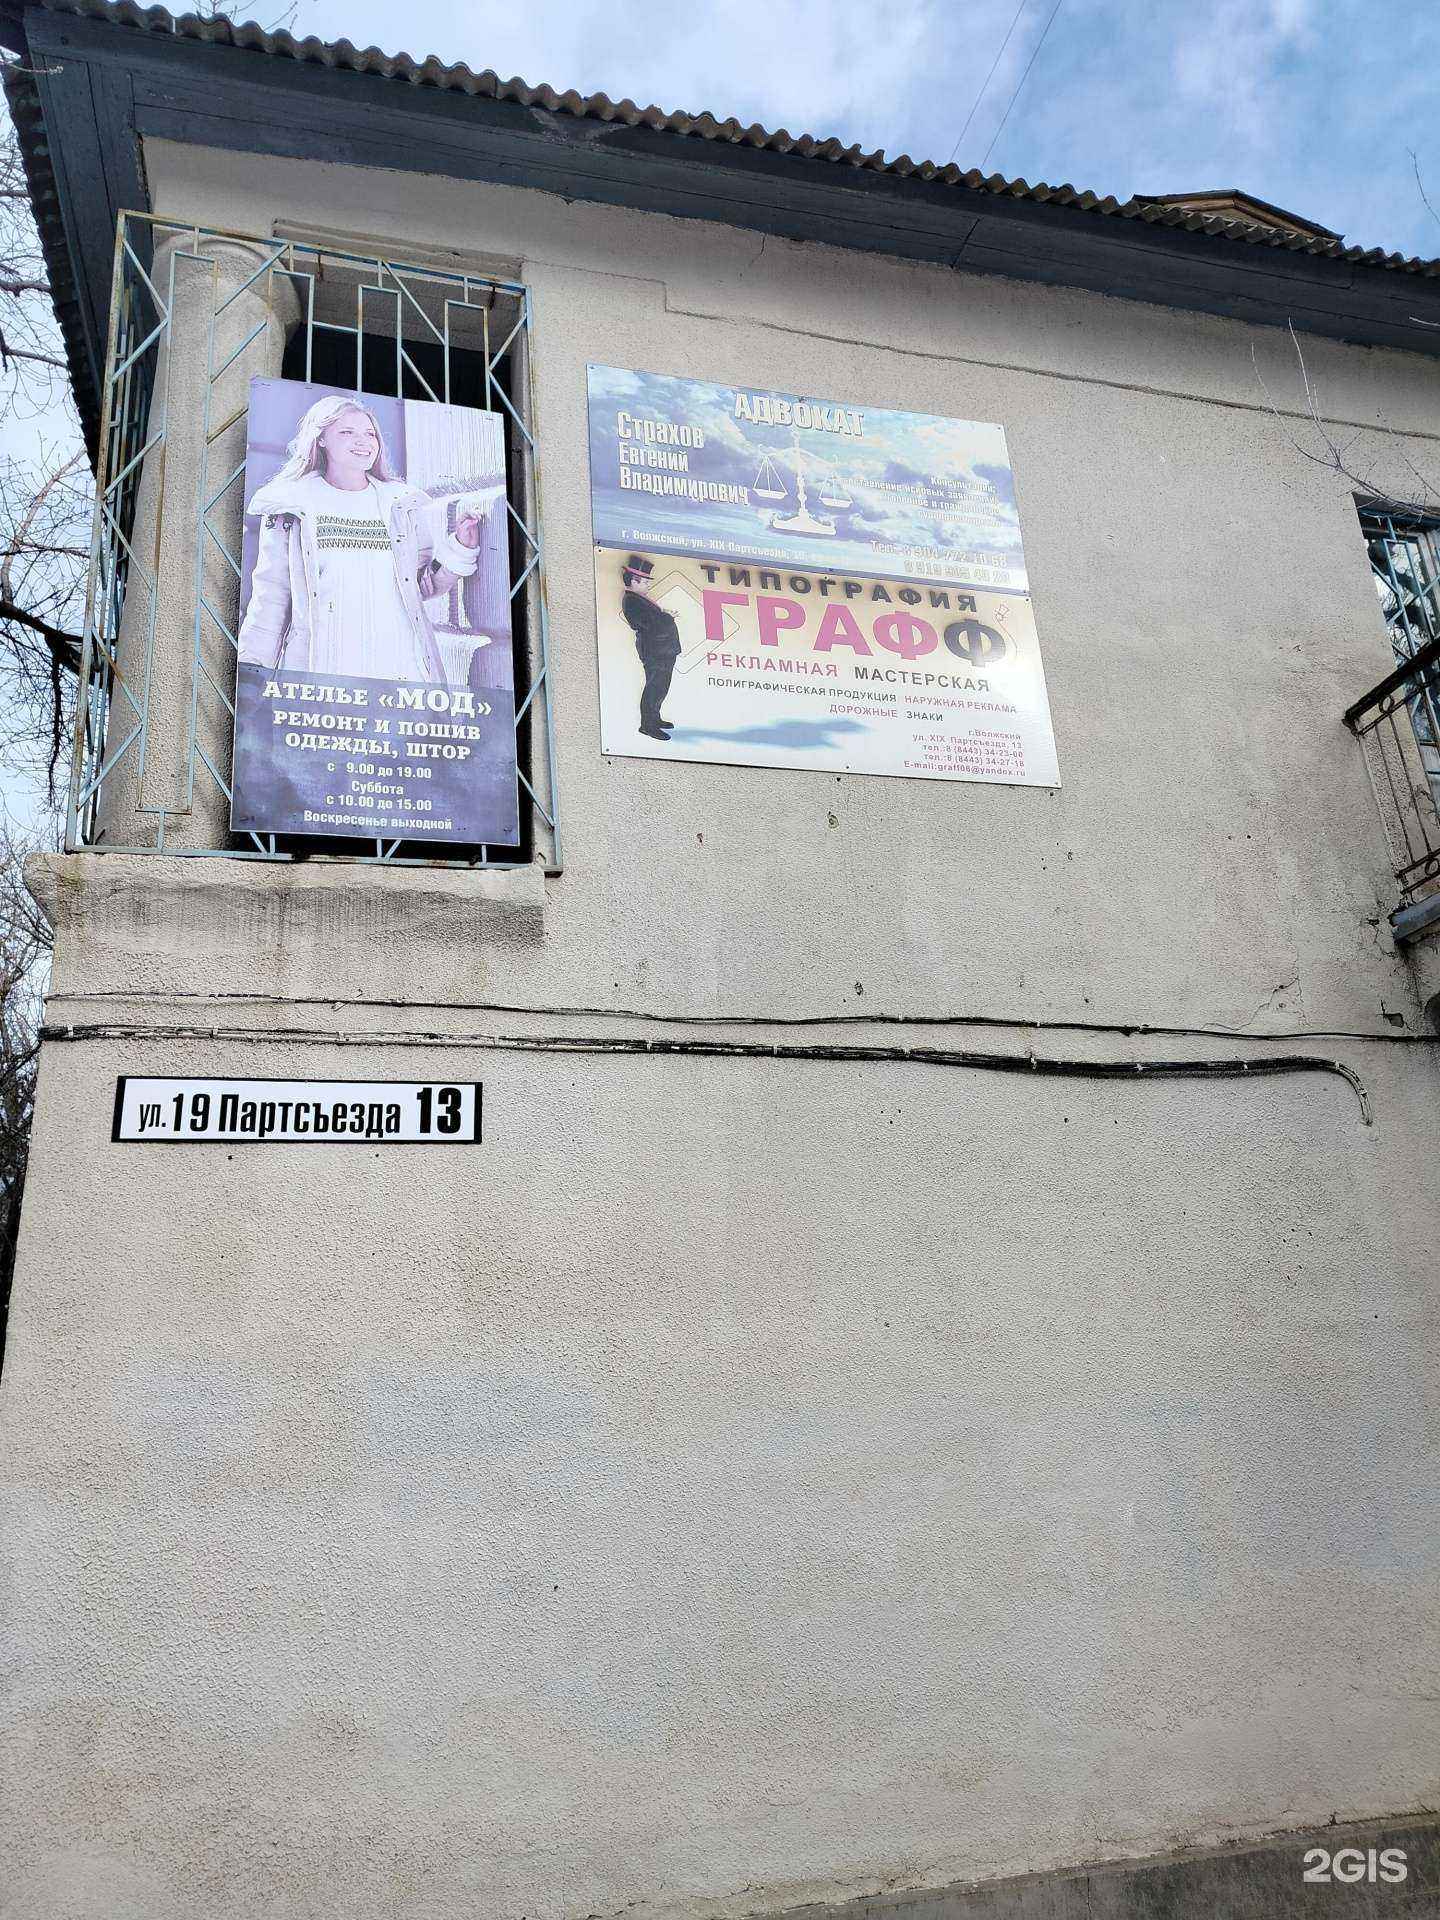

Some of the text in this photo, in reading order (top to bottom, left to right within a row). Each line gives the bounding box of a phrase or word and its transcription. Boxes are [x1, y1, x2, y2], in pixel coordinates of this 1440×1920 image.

[617, 412, 705, 449] Страхов
[735, 393, 864, 436] АДВОКАТ
[619, 442, 689, 472] Евгений
[620, 466, 750, 505] Владимирович
[622, 530, 629, 538] г.
[701, 565, 977, 612] ТИПОГРАФИЯ
[703, 590, 1006, 667] ГРАФФ
[706, 652, 990, 692] РЕКЛАМНАЯ МАСТЕРСКАЯ
[262, 681, 492, 718] АТЕЛЬЕ «МОД»
[708, 677, 1017, 713] ПОЛИГРАФИЧЕСКАЯ ПРОДУКЦИЯ НАРУЖНАЯ РЕКЛАМА
[273, 710, 481, 741] РЕМОНТ И ПОШИВ
[829, 704, 943, 722] ДОРОЖНЫЕ ЗНАКИ
[285, 732, 471, 760] ОДЕЖДЫ, ШТОР
[327, 762, 432, 779] с 9.00 до 19.00
[326, 794, 432, 811] с 10.00 до 15.00
[351, 780, 404, 796] Суббота
[304, 810, 453, 831] Воскресенье выходной
[138, 1086, 463, 1138] ул. 19 Партсъезда 13
